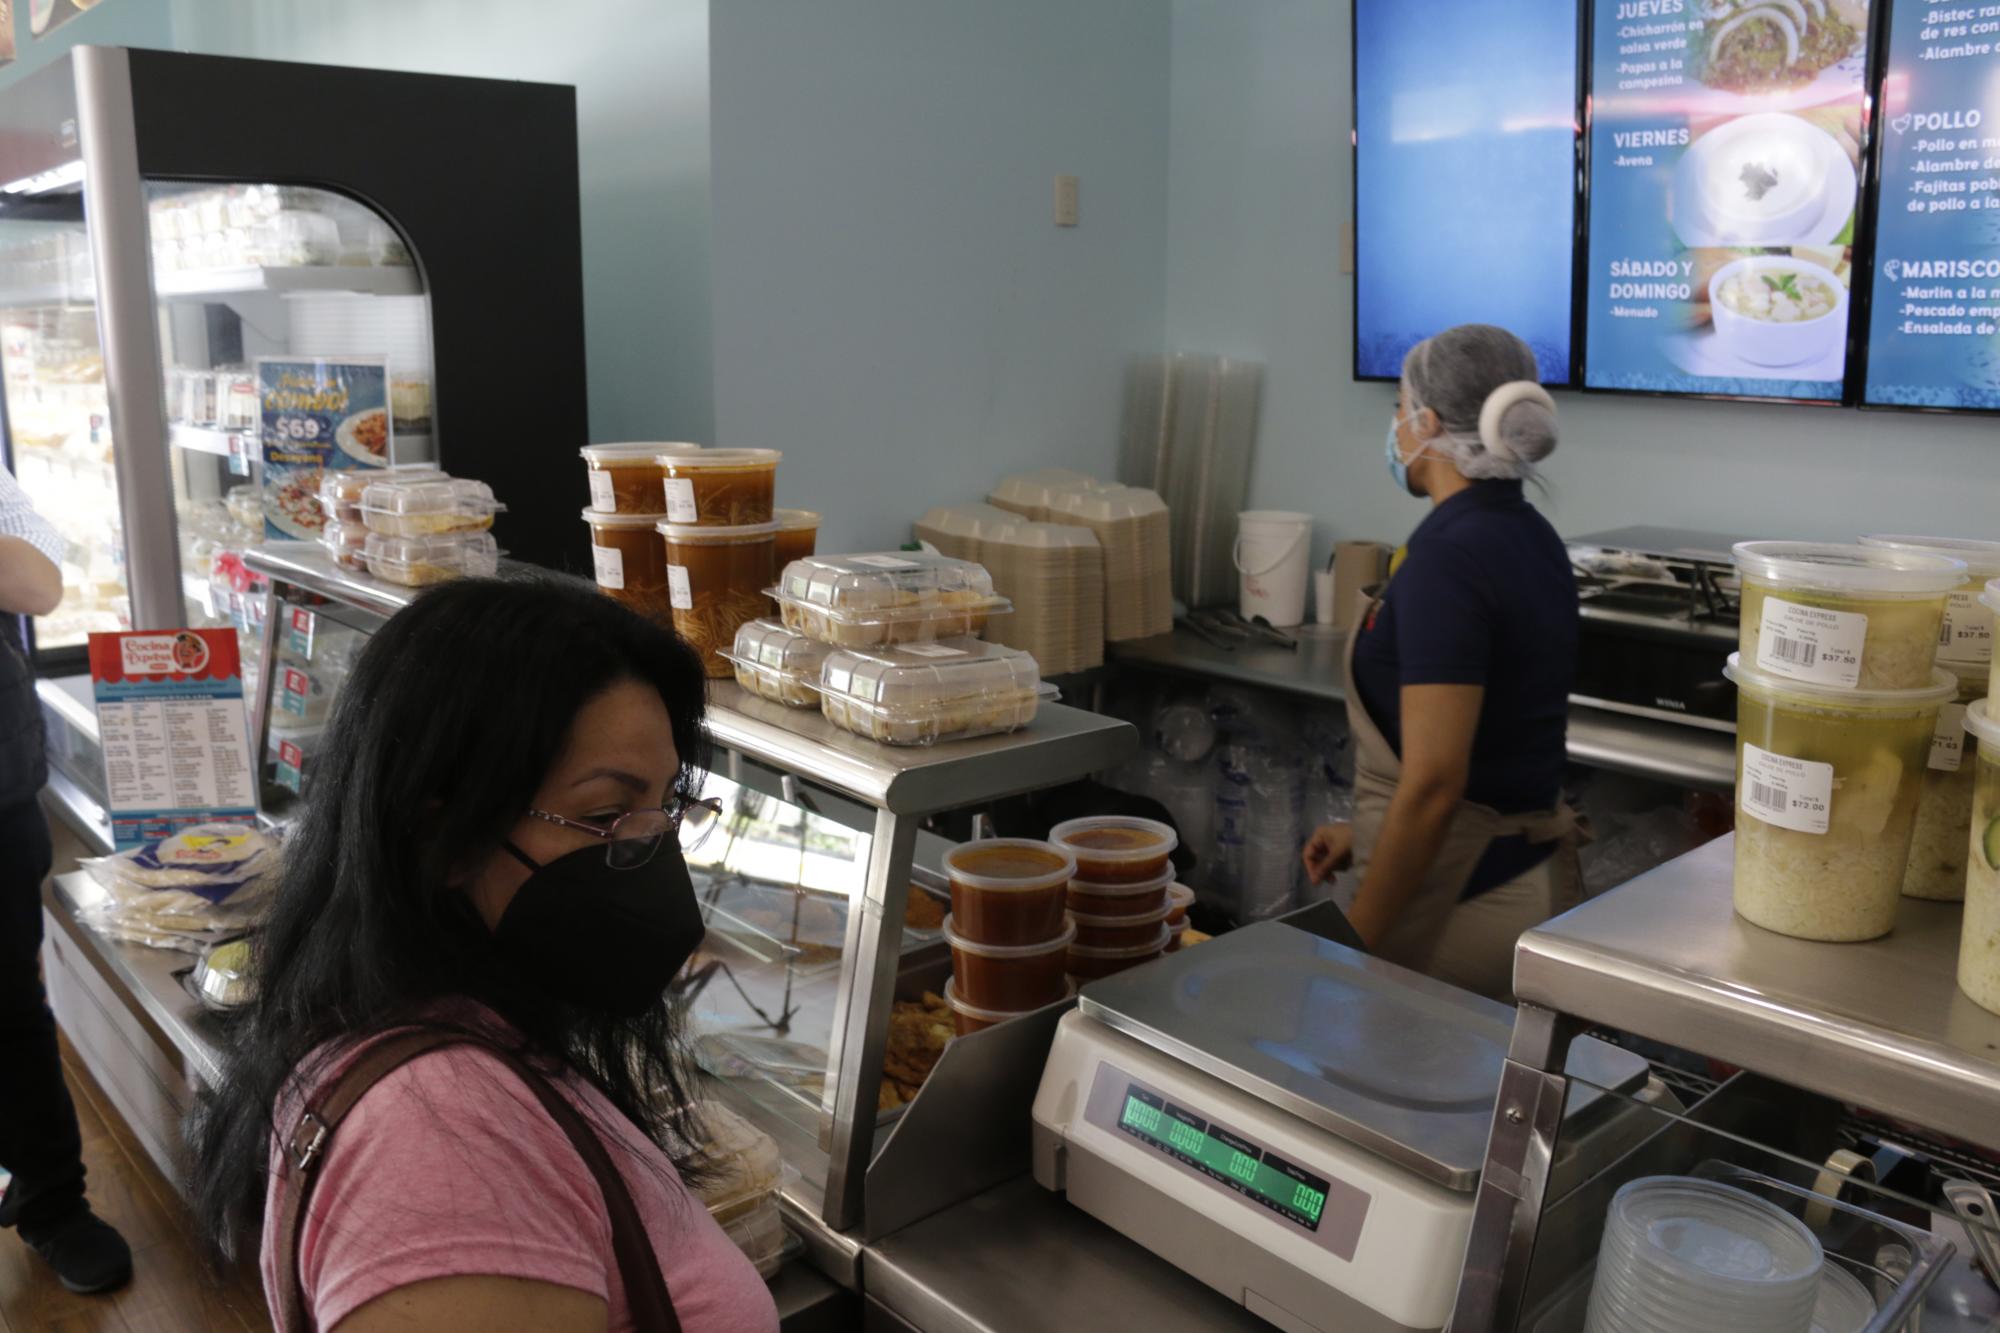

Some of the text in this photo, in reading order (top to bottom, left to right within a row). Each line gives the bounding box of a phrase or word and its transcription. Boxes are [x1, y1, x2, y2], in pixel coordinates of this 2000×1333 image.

[1616, 0, 1684, 20] JUEVES
[1922, 9, 1975, 24] -Bistec
[1688, 20, 1704, 31] en
[1920, 22, 2000, 40] de res con
[1620, 38, 1687, 55] salsa verde
[1919, 43, 1990, 60] -Alambre
[1616, 58, 1683, 75] -Papas a la
[1618, 75, 1683, 90] campesina
[1913, 109, 1981, 131] POLLO
[1613, 128, 1689, 148] VIERNES
[1912, 139, 1955, 152] -Pollo
[1958, 140, 1978, 150] en
[1613, 155, 1654, 167] -Avena
[1910, 158, 1979, 173] -Alambre
[1908, 180, 1966, 195] -Fajitas
[1907, 196, 2000, 214] de pollo a la
[1610, 257, 1693, 277] SÁBADO Y
[1610, 283, 1691, 300] DOMINGO
[1956, 289, 1967, 299] a
[1971, 286, 1986, 299] la
[1610, 306, 1659, 318] -Menudo
[1899, 303, 1965, 317] -Pescado
[1898, 321, 1995, 335] -Ensalada de
[275, 415, 319, 440] $69
[1788, 606, 1809, 617] COCINA
[1822, 653, 1856, 665] $37.50
[1791, 800, 1825, 811] $72.00
